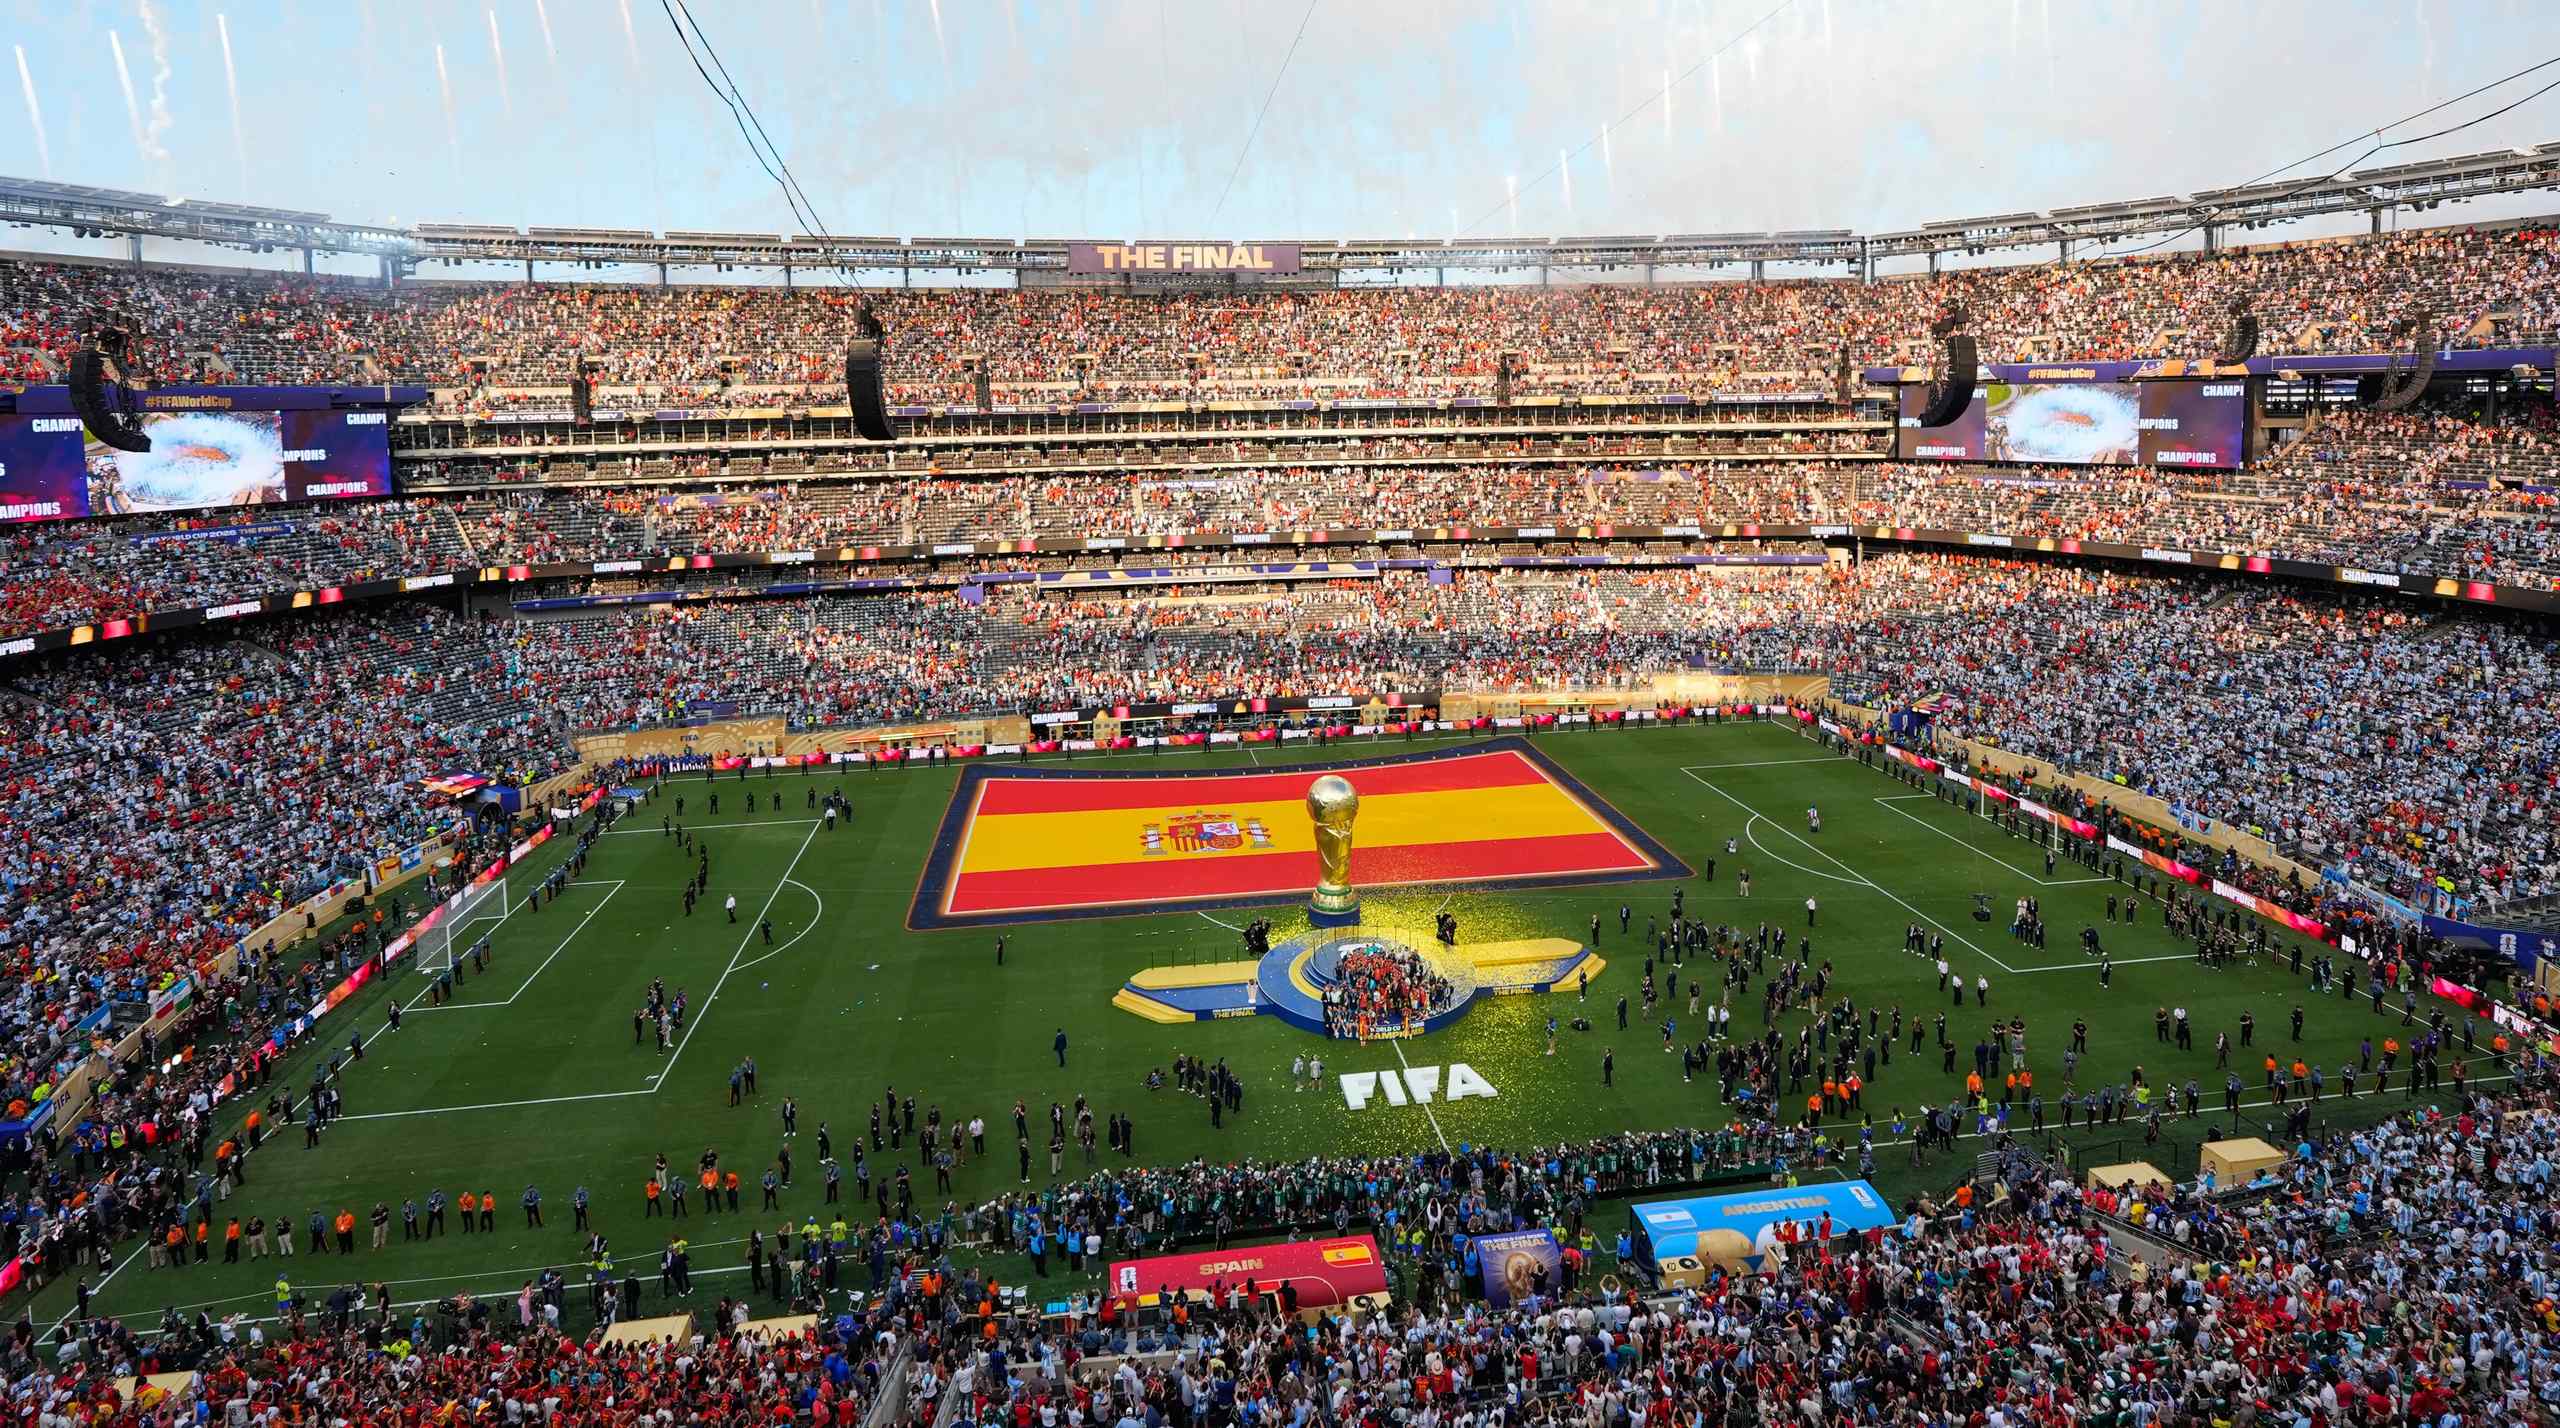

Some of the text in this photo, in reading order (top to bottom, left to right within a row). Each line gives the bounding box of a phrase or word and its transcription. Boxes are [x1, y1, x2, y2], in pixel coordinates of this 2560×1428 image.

[1096, 246, 1273, 269] THE FINAL
[2028, 368, 2096, 381] #FIFAWorldCup
[145, 395, 233, 408] #FIFAWorldCup
[1916, 446, 1966, 457] CHAMPIONS
[2157, 451, 2217, 463] CHAMPIONS
[306, 481, 368, 496] CHAMPIONS
[209, 530, 237, 538] 2026
[2142, 548, 2192, 563] CHAMPIONS
[2342, 569, 2400, 587] CHAMPIONS
[206, 600, 261, 619] CHAMPIONS
[1031, 711, 1079, 725] CHAMPIONS
[1214, 1010, 1231, 1019] THE
[1231, 1008, 1256, 1017] FINAL
[1339, 1063, 1499, 1110] FIFA
[1723, 1196, 1830, 1216] ARGENTINA
[1484, 1237, 1550, 1251] THE FINAL
[1199, 1258, 1264, 1276] SPAIN
